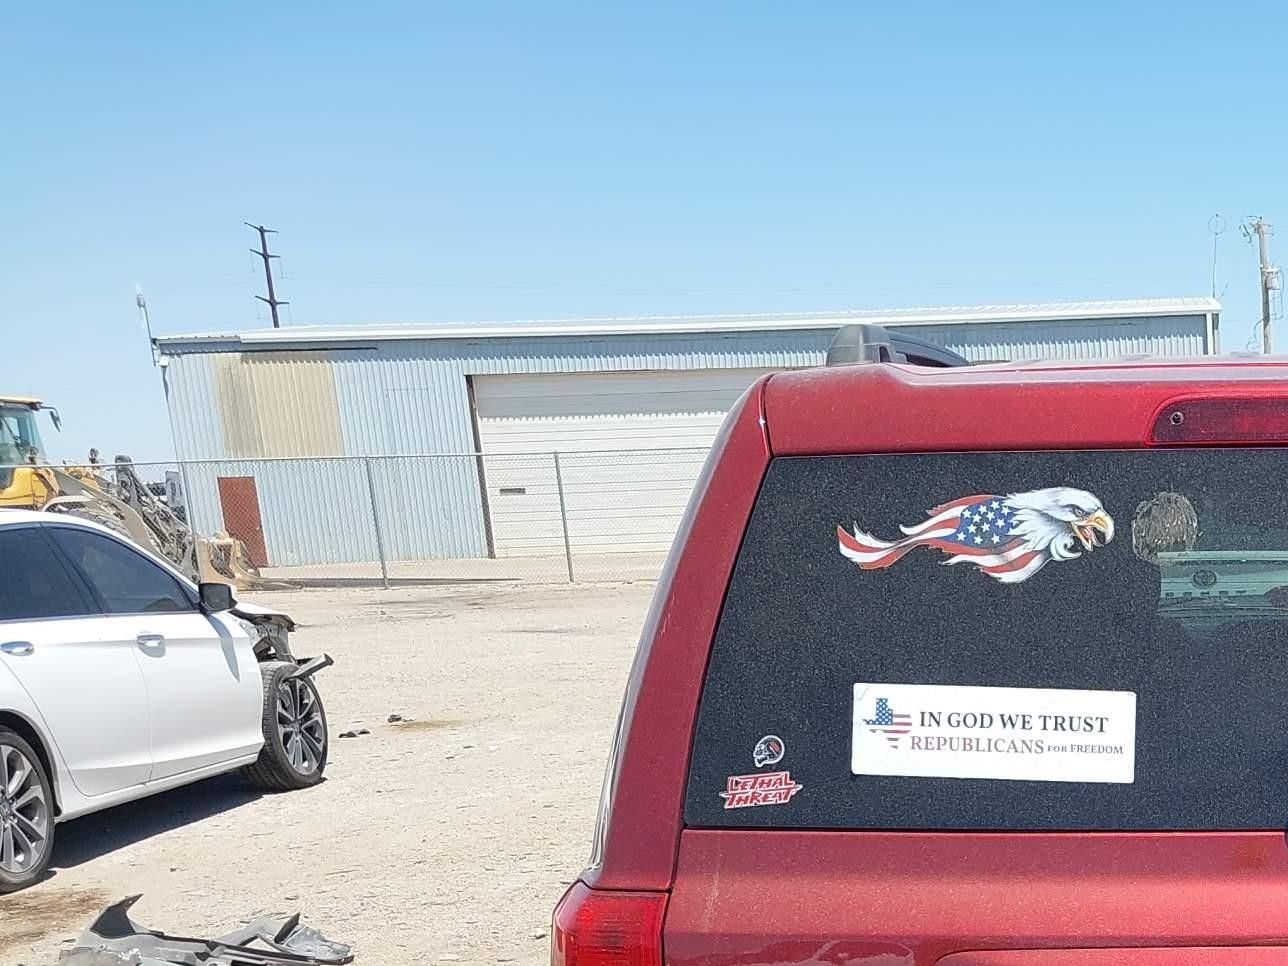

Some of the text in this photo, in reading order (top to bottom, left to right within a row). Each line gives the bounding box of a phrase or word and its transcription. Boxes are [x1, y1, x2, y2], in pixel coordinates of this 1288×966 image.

[919, 711, 1109, 733] IN GOD WE TRUST
[910, 735, 1123, 755] REPUBLICANS FOR FREEDOM
